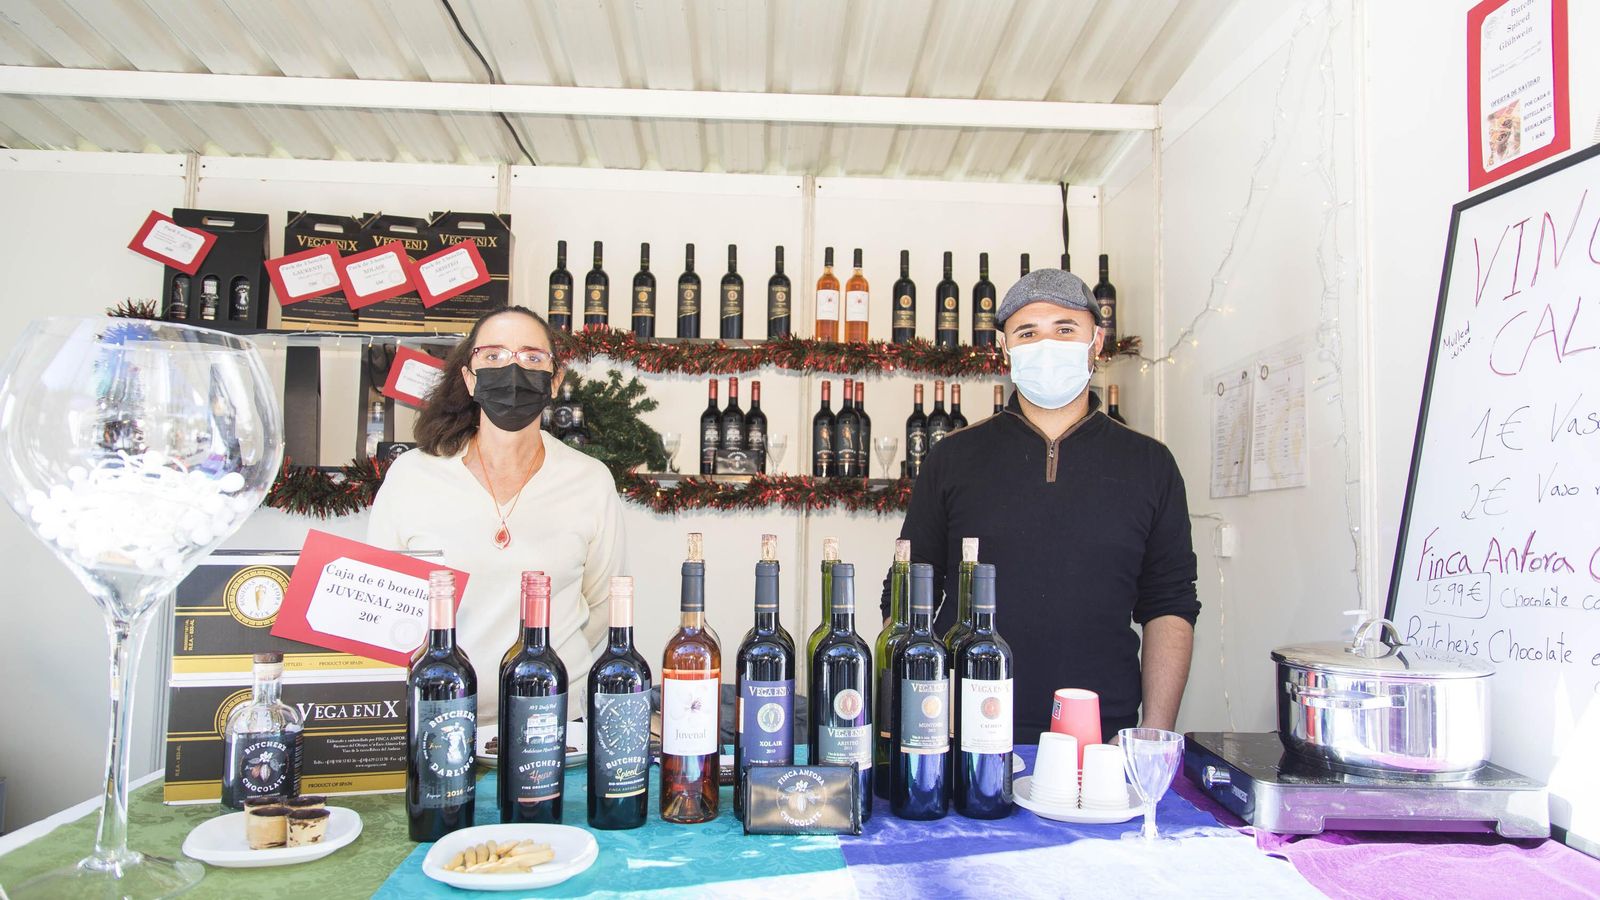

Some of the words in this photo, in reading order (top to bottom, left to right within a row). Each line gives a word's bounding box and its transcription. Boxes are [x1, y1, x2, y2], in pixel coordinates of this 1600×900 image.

[1507, 12, 1530, 32] Spiced
[1490, 93, 1510, 107] OFERTA
[1534, 93, 1546, 103] CADA
[1524, 106, 1546, 120] BOTELLAS
[330, 240, 358, 251] NIX
[474, 236, 498, 247] NIX
[1443, 320, 1470, 350] Mulled
[1490, 296, 1598, 376] CAL
[1451, 337, 1471, 360] wine
[1468, 405, 1530, 464] 1€
[1461, 477, 1511, 520] 2€
[1538, 462, 1580, 504] Vaso
[1417, 526, 1472, 581] Finca
[1482, 530, 1575, 574] Anfora
[326, 564, 354, 580] Caja
[358, 573, 374, 585] de
[378, 578, 384, 588] 6
[388, 581, 430, 601] botella
[326, 584, 392, 609] JUVENAL
[396, 602, 424, 617] 2018
[1500, 586, 1569, 609] Chocolate
[358, 611, 382, 624] 20€
[1489, 628, 1573, 663] Chocolate
[296, 703, 348, 721] VEGA
[352, 700, 400, 718] ENIX
[676, 729, 706, 740] Juvenal
[430, 755, 474, 777] DARLING
[242, 774, 286, 792] CHOCOLATE
[777, 769, 798, 785] FINCA
[799, 769, 825, 786] ANFORA
[780, 811, 822, 826] CHOCOLATE
